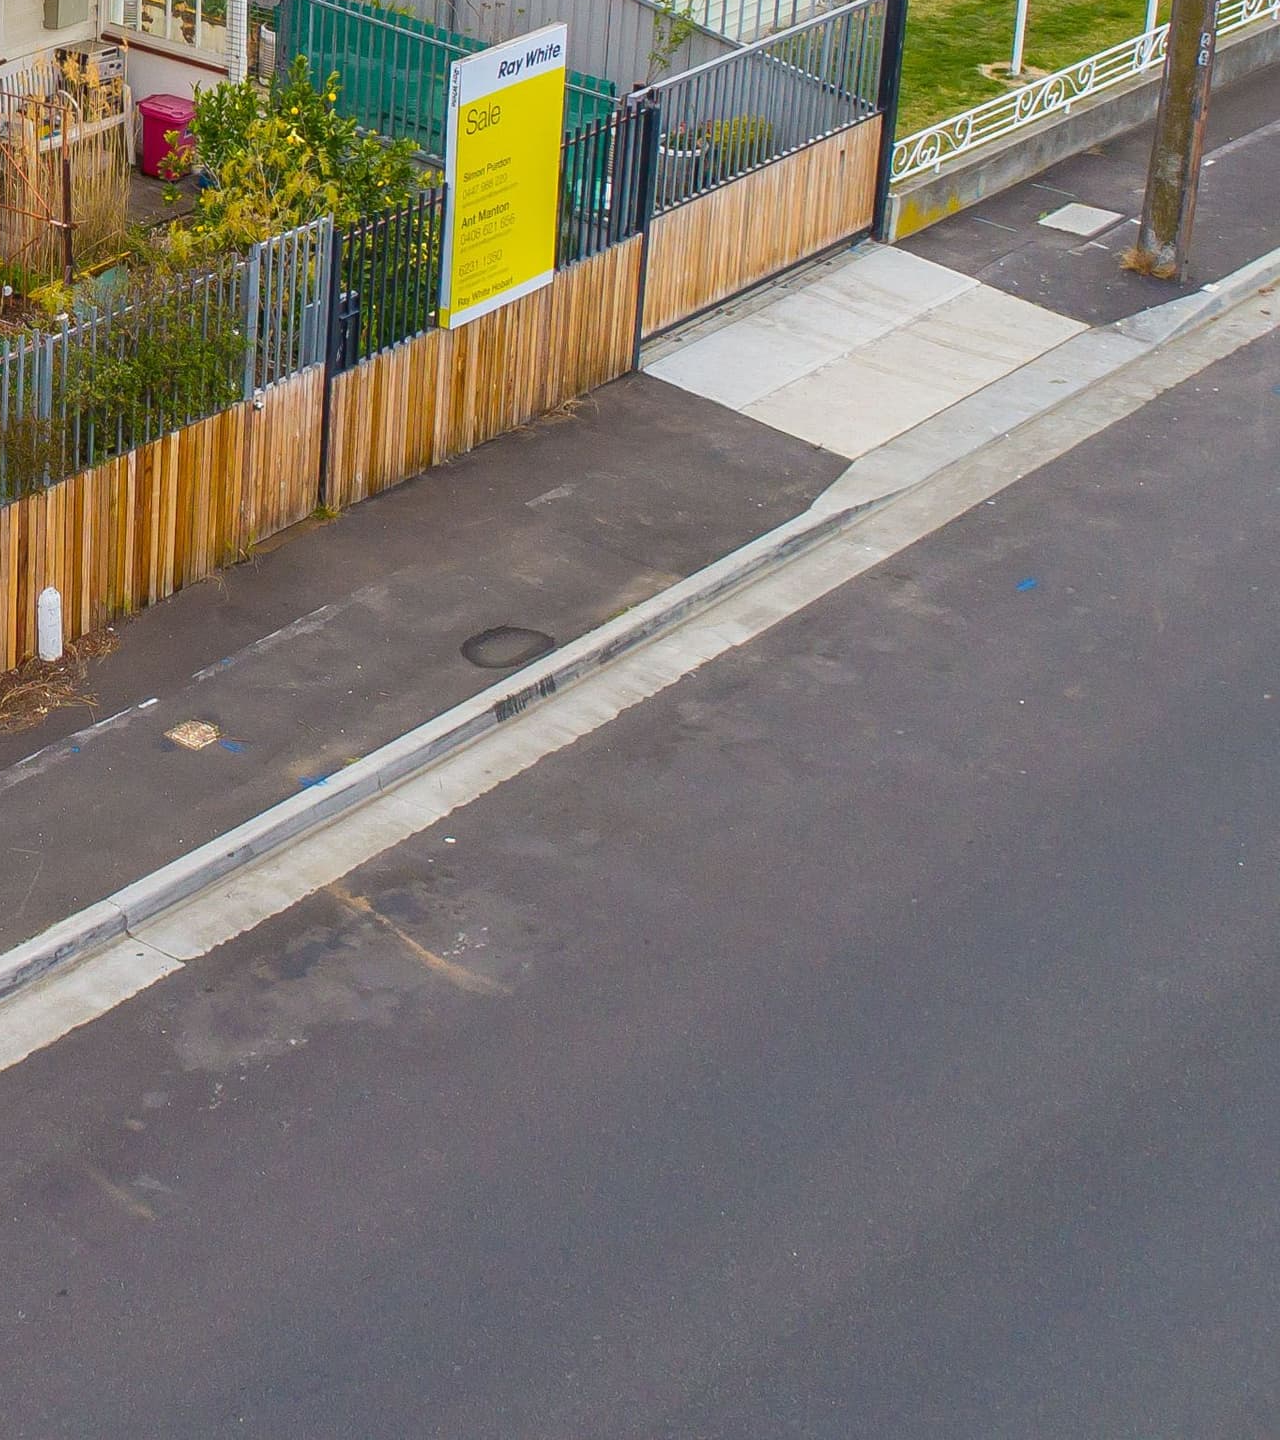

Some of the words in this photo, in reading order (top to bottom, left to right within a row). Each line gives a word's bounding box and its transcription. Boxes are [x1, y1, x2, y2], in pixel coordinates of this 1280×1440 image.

[497, 57, 523, 79] Ray
[525, 43, 561, 68] White
[466, 102, 501, 136] Sale
[461, 214, 476, 229] Ant
[478, 202, 510, 222] Manton
